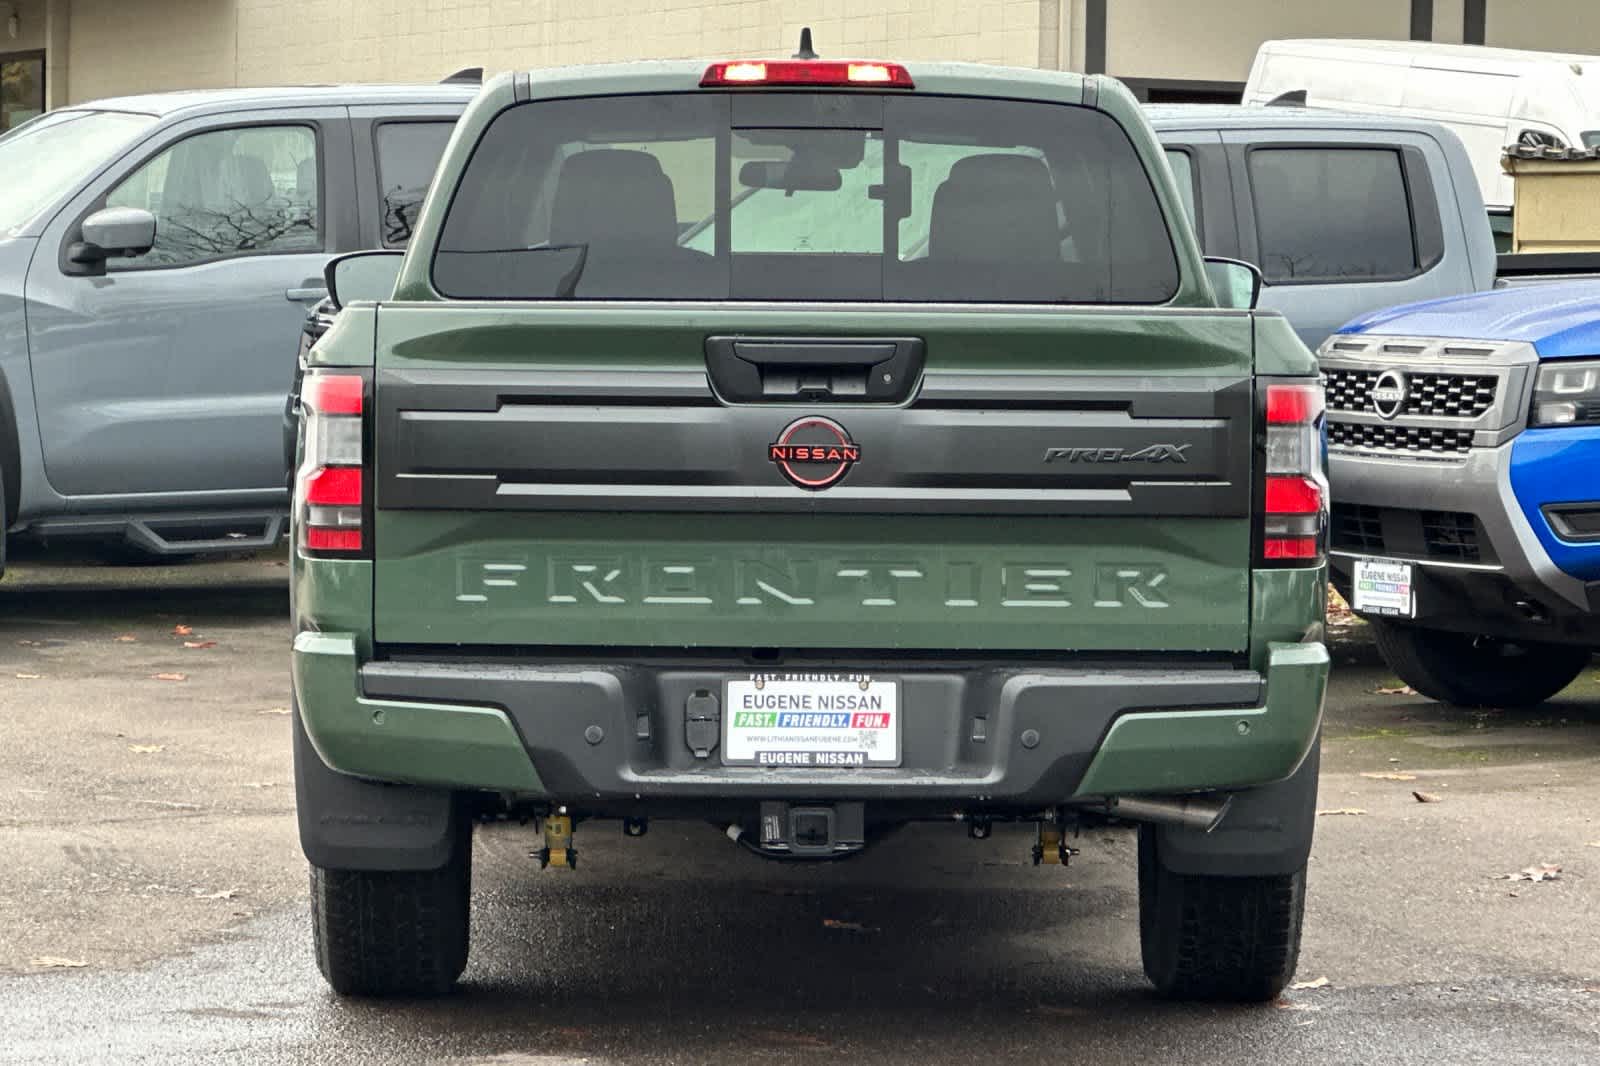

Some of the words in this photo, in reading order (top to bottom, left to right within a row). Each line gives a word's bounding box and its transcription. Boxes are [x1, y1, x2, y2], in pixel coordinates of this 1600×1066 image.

[771, 446, 858, 461] NISSAN
[1043, 444, 1191, 464] PRO-4X
[454, 553, 1170, 610] FRONTIER
[743, 694, 812, 709] EUGENE
[818, 695, 882, 710] NISSAN
[738, 713, 774, 727] FAST.
[781, 713, 848, 728] FRIENDLY.
[857, 713, 887, 728] FUN.
[759, 752, 810, 764] EUGENE
[816, 752, 863, 764] NISSAN
